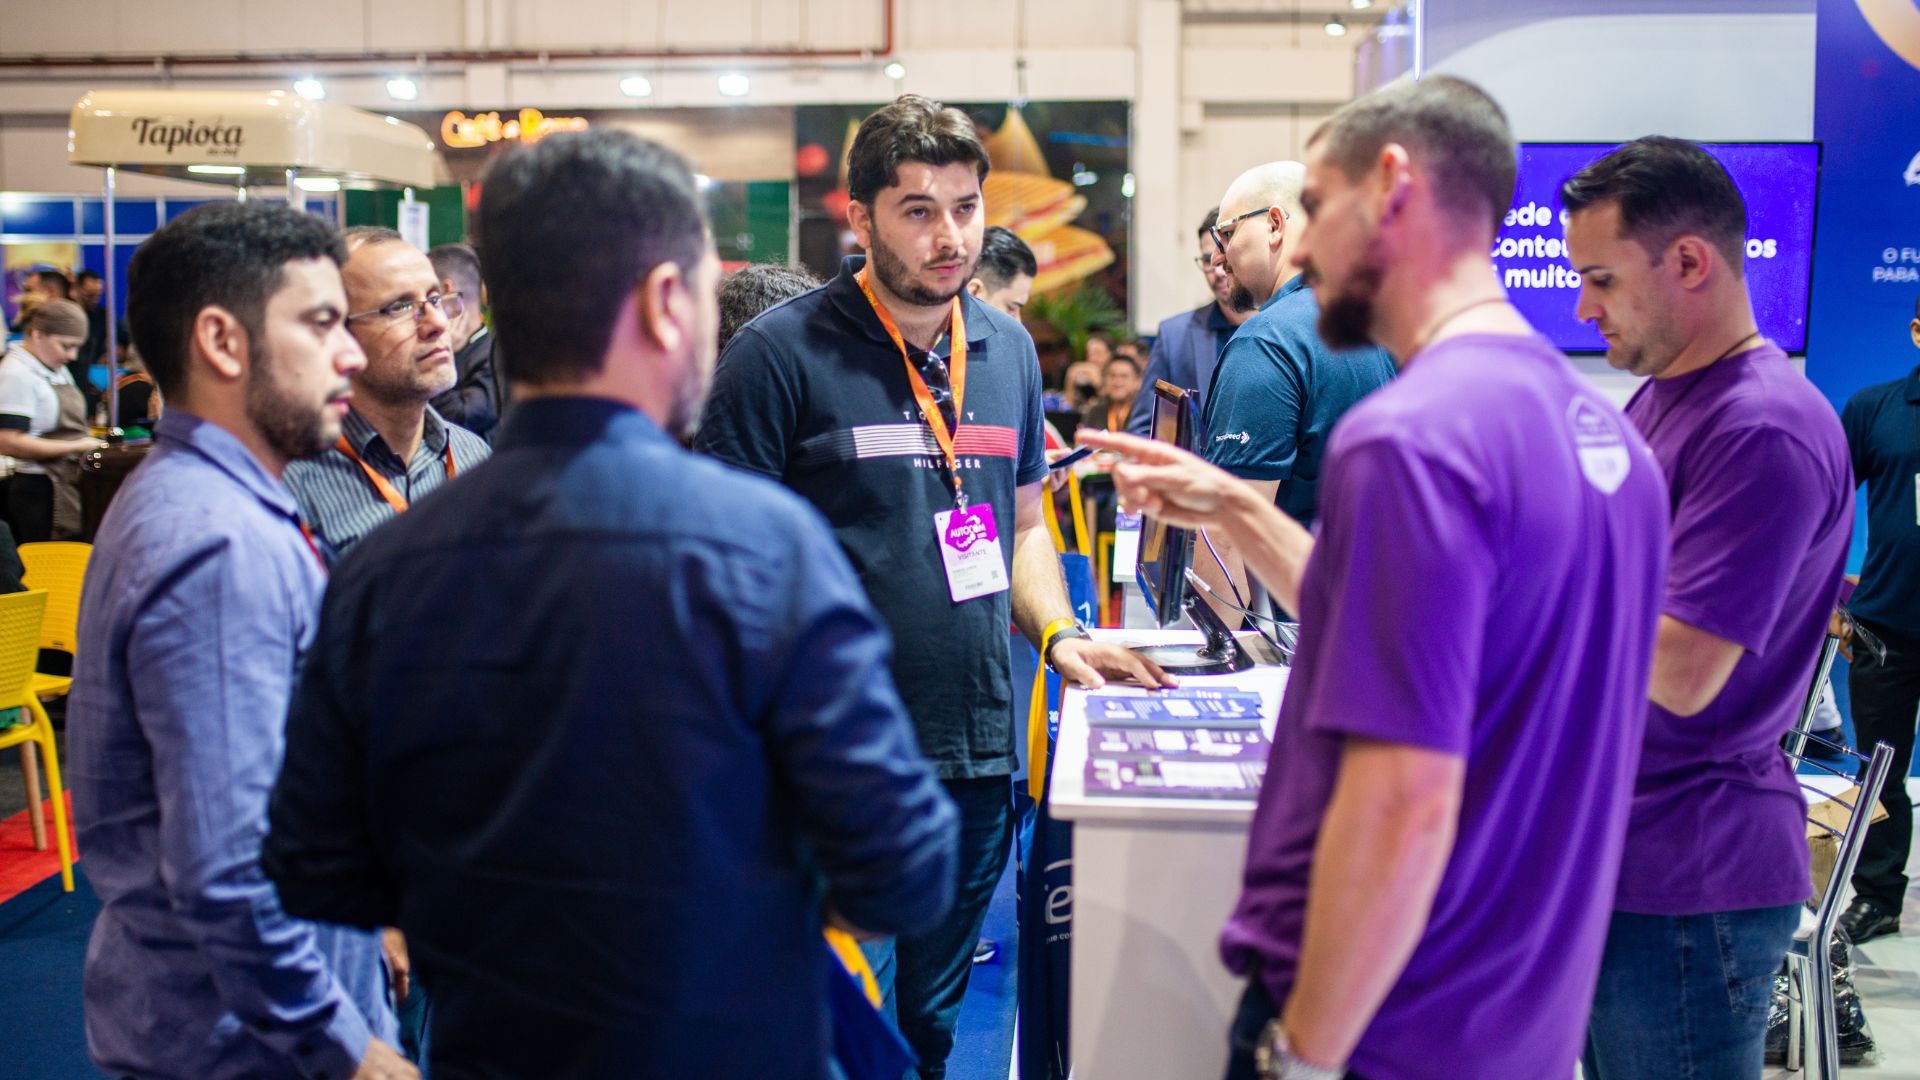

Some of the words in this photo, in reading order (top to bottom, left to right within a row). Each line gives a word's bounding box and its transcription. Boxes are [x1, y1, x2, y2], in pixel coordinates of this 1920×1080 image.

[132, 115, 244, 154] Tapioca
[1504, 201, 1552, 226] ede
[1901, 247, 1920, 264] FU
[1872, 266, 1919, 283] PARA
[903, 410, 975, 421] TOY
[950, 523, 986, 539] AUTOCOM
[957, 548, 987, 561] VISITANTE
